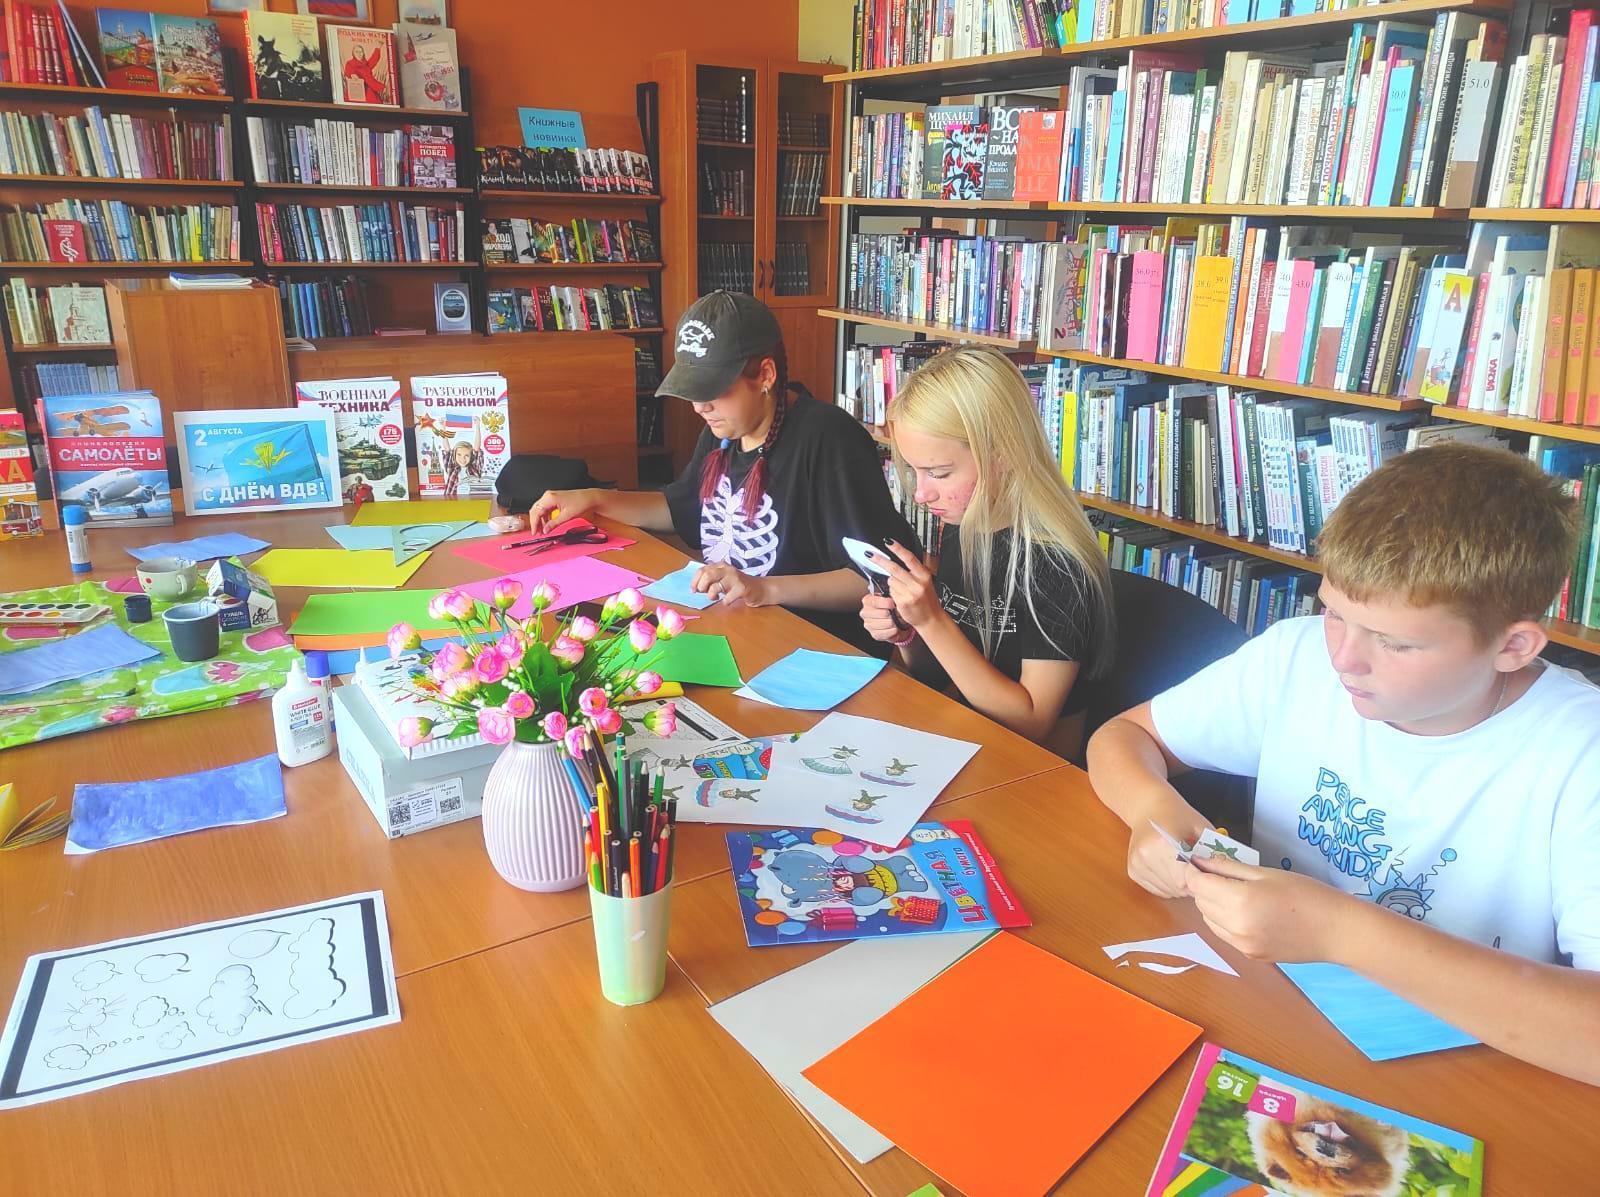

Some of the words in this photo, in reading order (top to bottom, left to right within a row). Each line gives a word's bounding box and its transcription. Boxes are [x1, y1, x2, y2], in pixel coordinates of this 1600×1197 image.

[528, 116, 575, 129] Книжные
[928, 112, 974, 121] МИХАИЛ
[533, 134, 577, 143] новинки
[1321, 134, 1335, 182] ПОЗНАЮ
[1329, 106, 1339, 132] МИР
[420, 149, 447, 157] ПОБЕД
[988, 144, 1017, 155] ПРОДА
[1362, 346, 1376, 379] ЛЕГЕНДЫ
[1377, 285, 1389, 317] СОБАКАХ
[318, 388, 387, 401] ВОЕННАЯ
[422, 387, 496, 396] РАЗГОВОРЫ
[424, 399, 433, 408] О
[437, 397, 497, 407] ВАЖНОМ
[194, 429, 208, 447] 2
[207, 427, 243, 436] АВГУСТА
[59, 446, 162, 462] САМОЛЁТЫ
[202, 489, 214, 502] С
[219, 481, 275, 504] ДНЁМ
[280, 481, 325, 500] ВДВ!
[923, 849, 988, 923] ЦВЕТНАЯ
[1217, 1074, 1243, 1098] 16
[1262, 1097, 1280, 1114] 8
